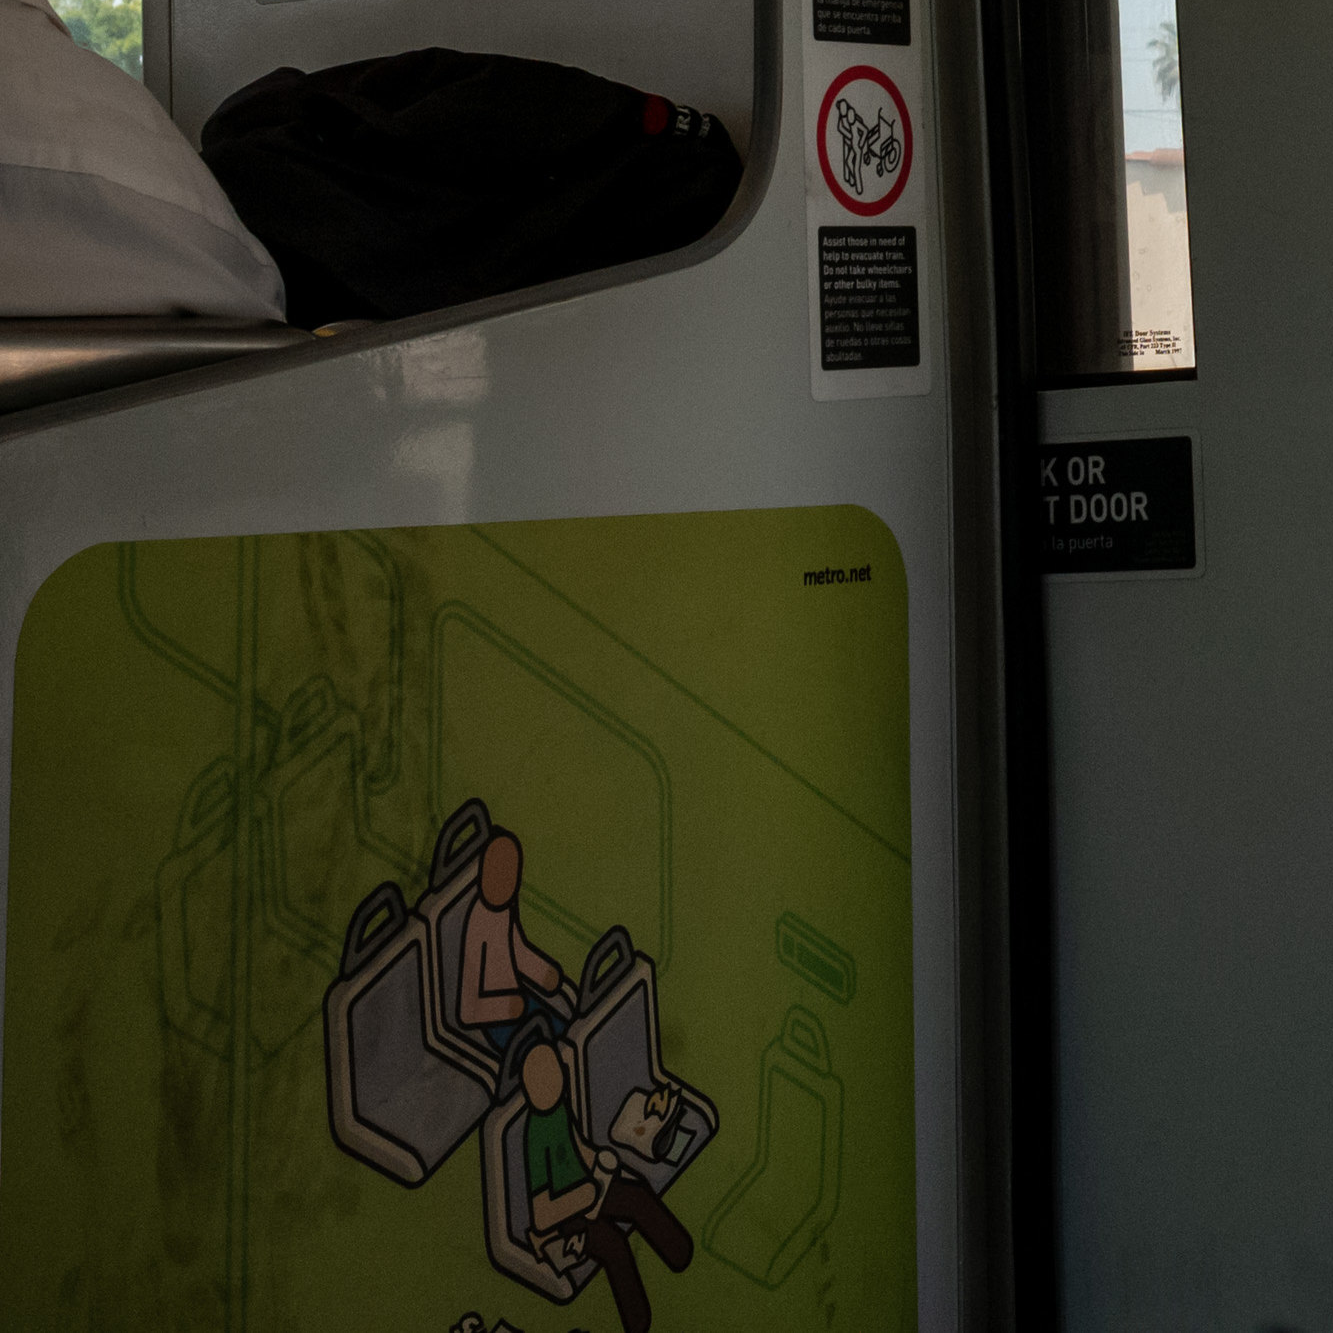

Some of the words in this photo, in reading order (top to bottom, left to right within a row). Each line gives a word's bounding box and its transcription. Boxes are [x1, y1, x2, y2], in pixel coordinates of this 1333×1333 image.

[823, 236, 846, 247] Assist
[847, 236, 868, 247] those
[870, 237, 877, 247] in
[878, 236, 896, 247] need
[898, 236, 905, 247] of
[823, 251, 840, 263] help
[841, 251, 849, 261] to
[851, 251, 884, 261] evacuate
[823, 265, 834, 275] Do
[835, 265, 847, 275] not
[849, 265, 866, 275] take
[868, 264, 912, 275] wheelchairs
[824, 281, 834, 290] or
[834, 279, 855, 290] other
[856, 278, 877, 291] bulky
[1067, 455, 1106, 486] OR
[1043, 495, 1060, 525] T
[1069, 491, 1149, 524] DOOR
[1069, 535, 1114, 555] puerta
[803, 563, 872, 586] metro.net
